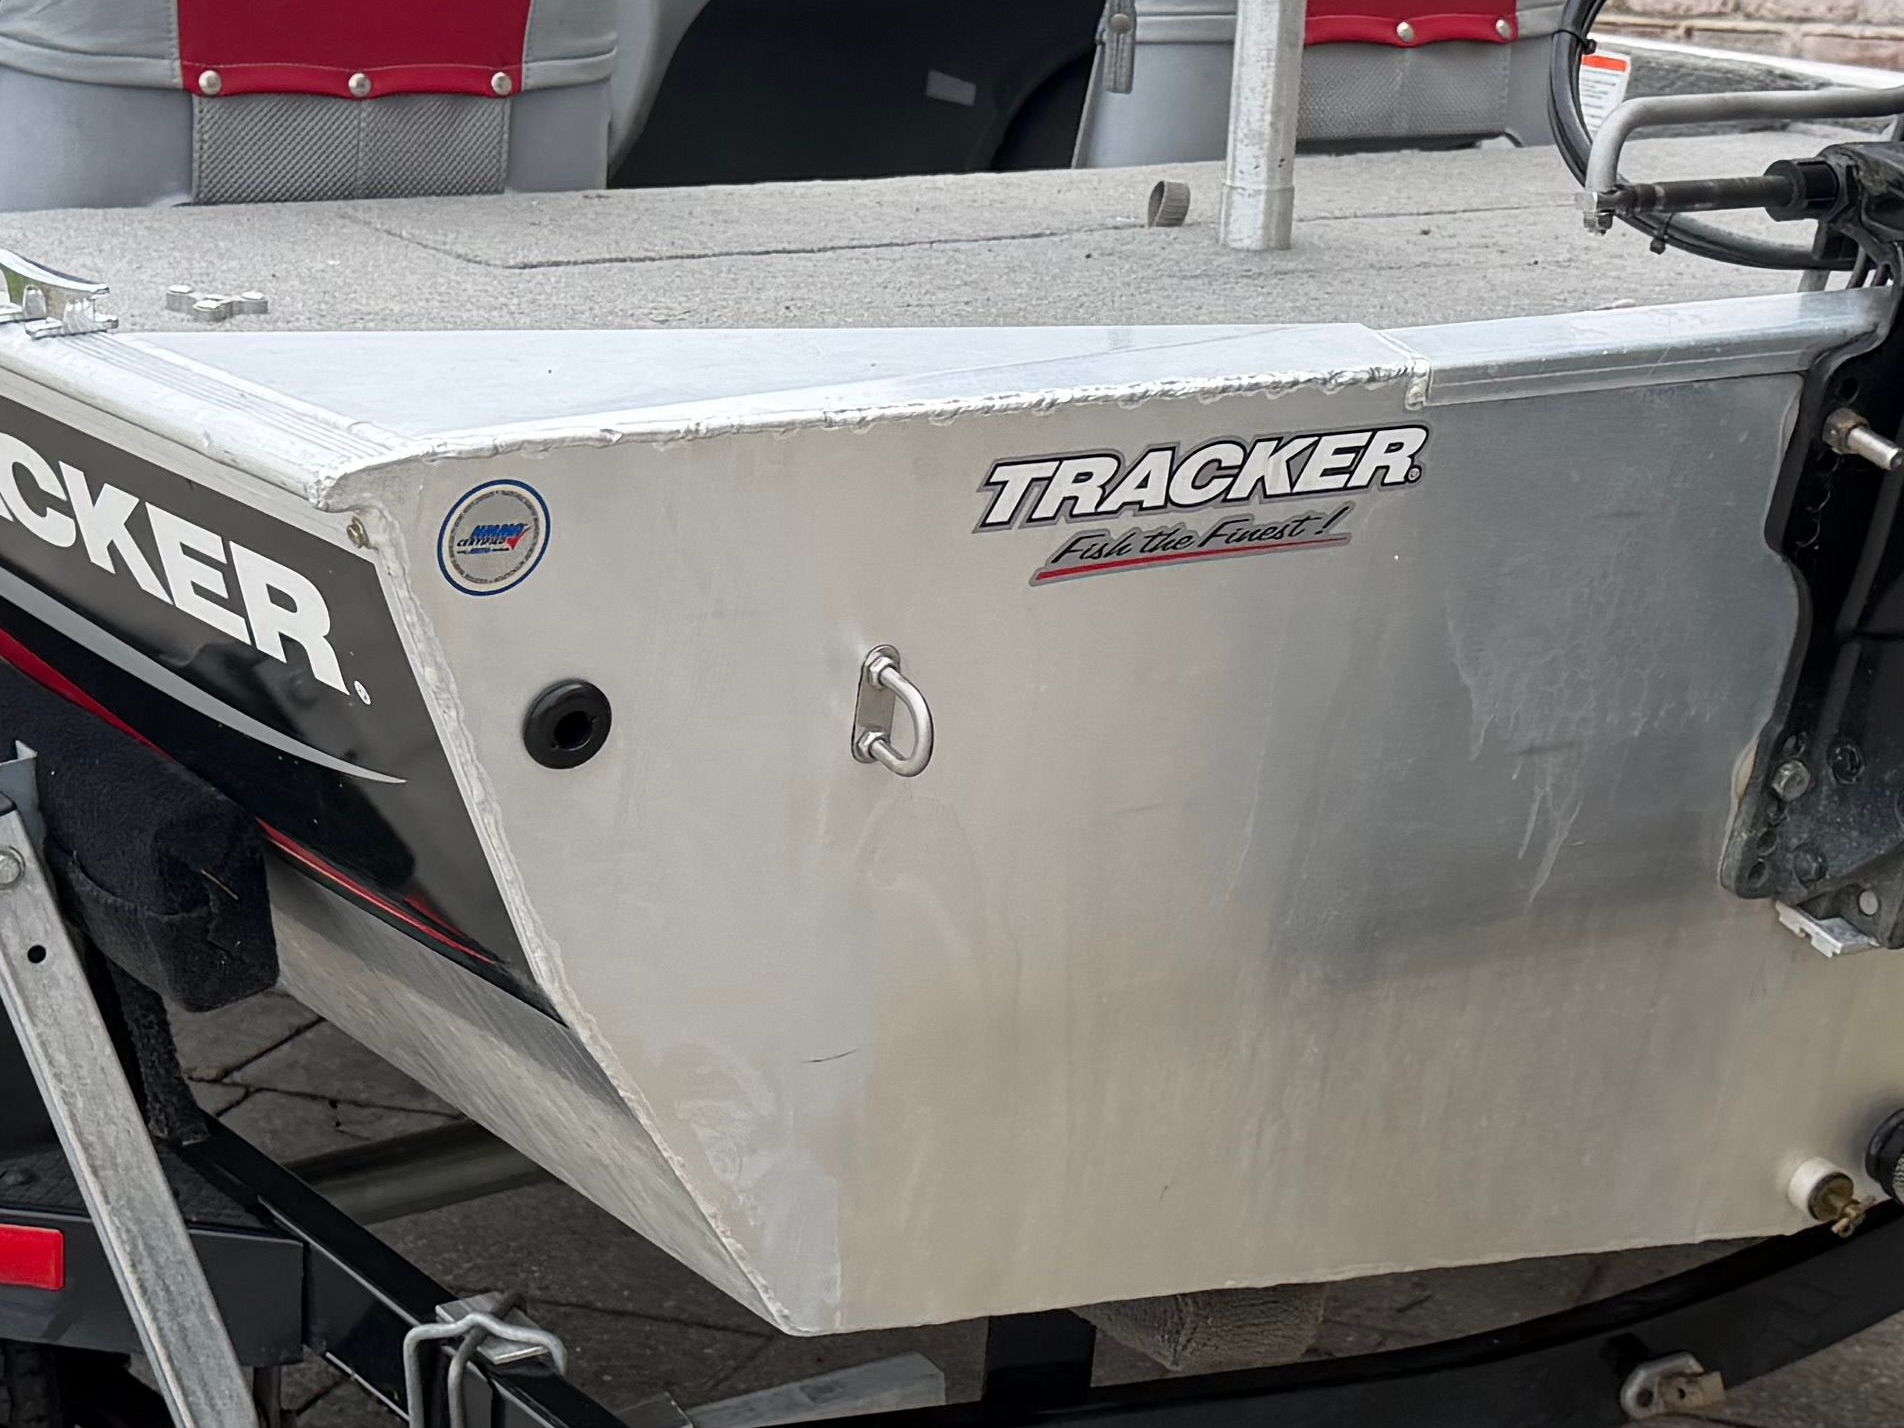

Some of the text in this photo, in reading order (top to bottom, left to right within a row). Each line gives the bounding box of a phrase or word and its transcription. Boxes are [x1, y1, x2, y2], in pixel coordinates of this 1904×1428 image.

[983, 424, 1428, 526] TRACKER
[1050, 532, 1132, 564] Fish
[1138, 527, 1195, 554] the
